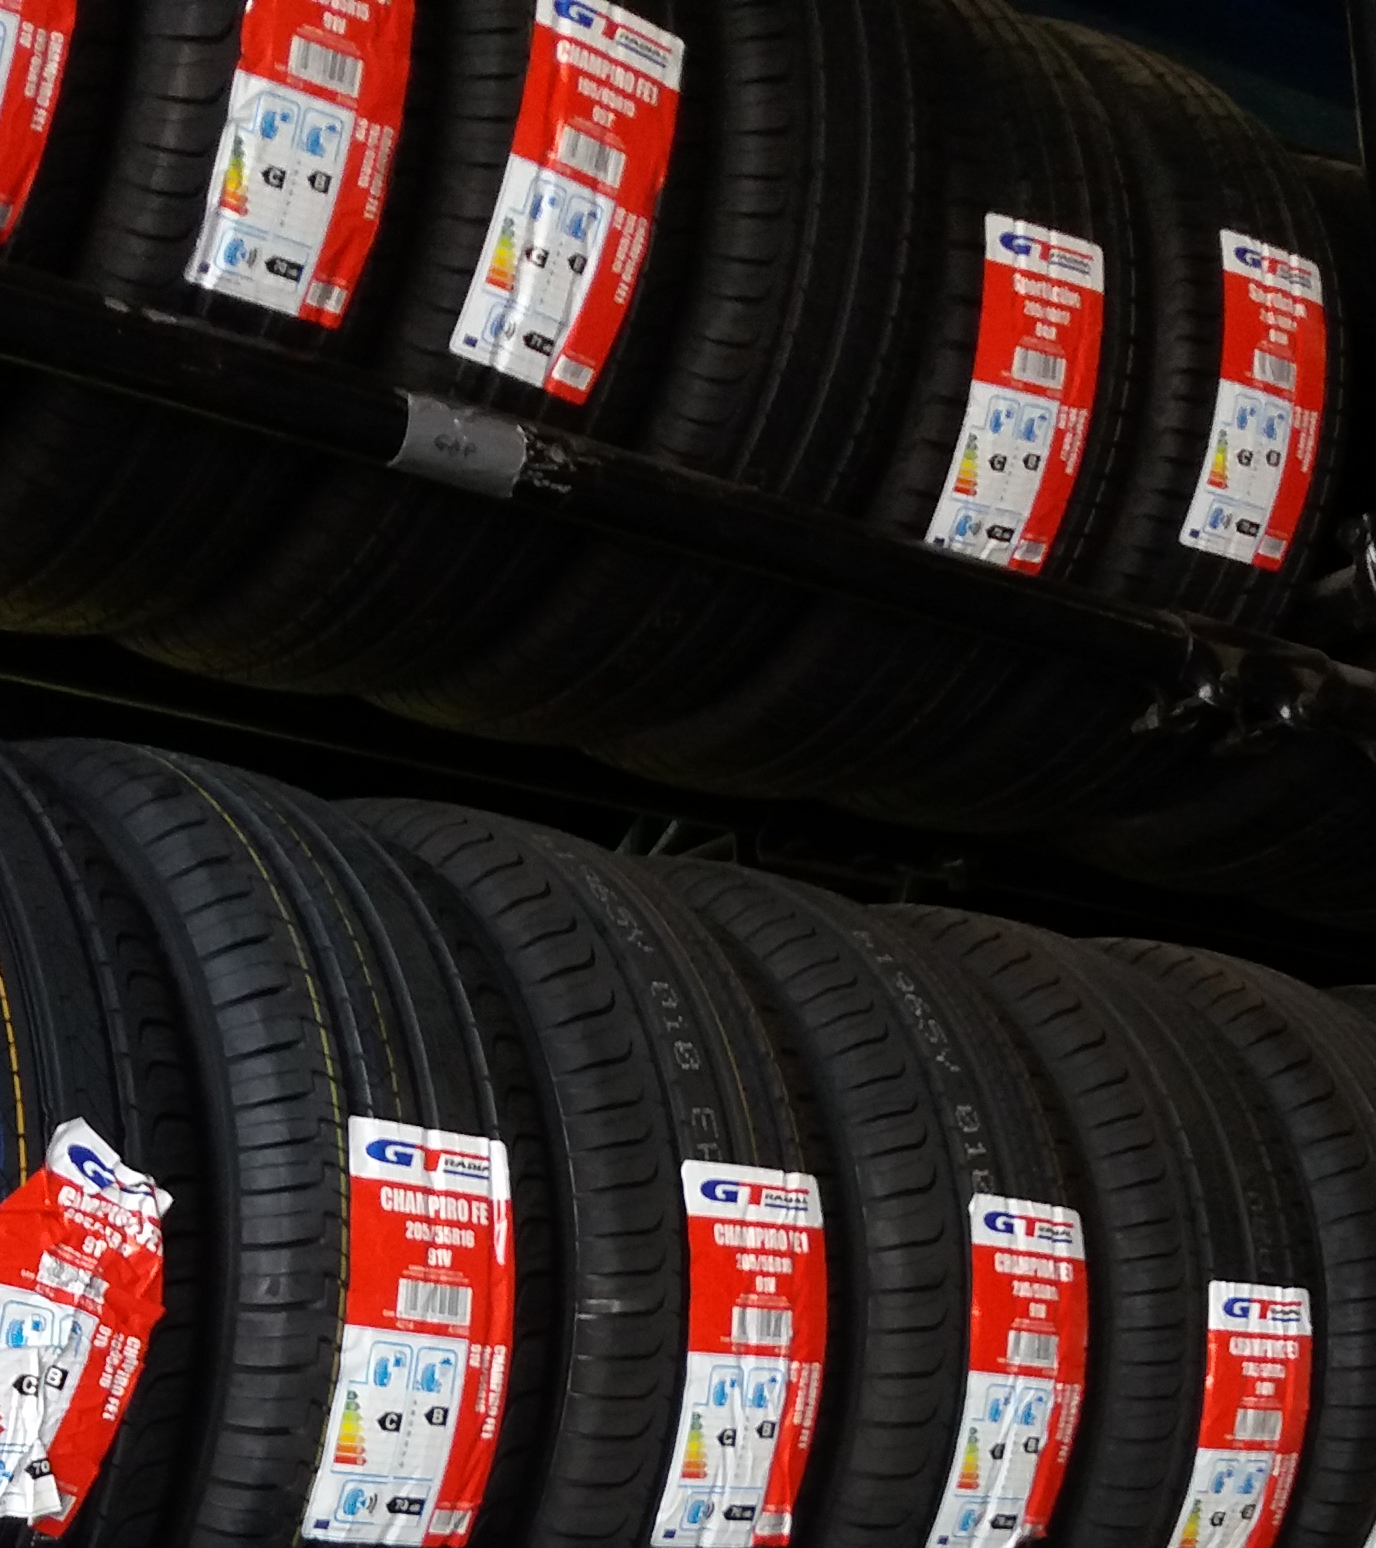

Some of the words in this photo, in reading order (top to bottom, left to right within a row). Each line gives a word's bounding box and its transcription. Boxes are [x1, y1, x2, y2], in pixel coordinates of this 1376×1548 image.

[46, 1367, 63, 1386] B
[22, 1378, 39, 1395] C
[384, 1415, 398, 1430] C
[432, 1408, 444, 1424] B
[33, 1460, 51, 1474] 70
